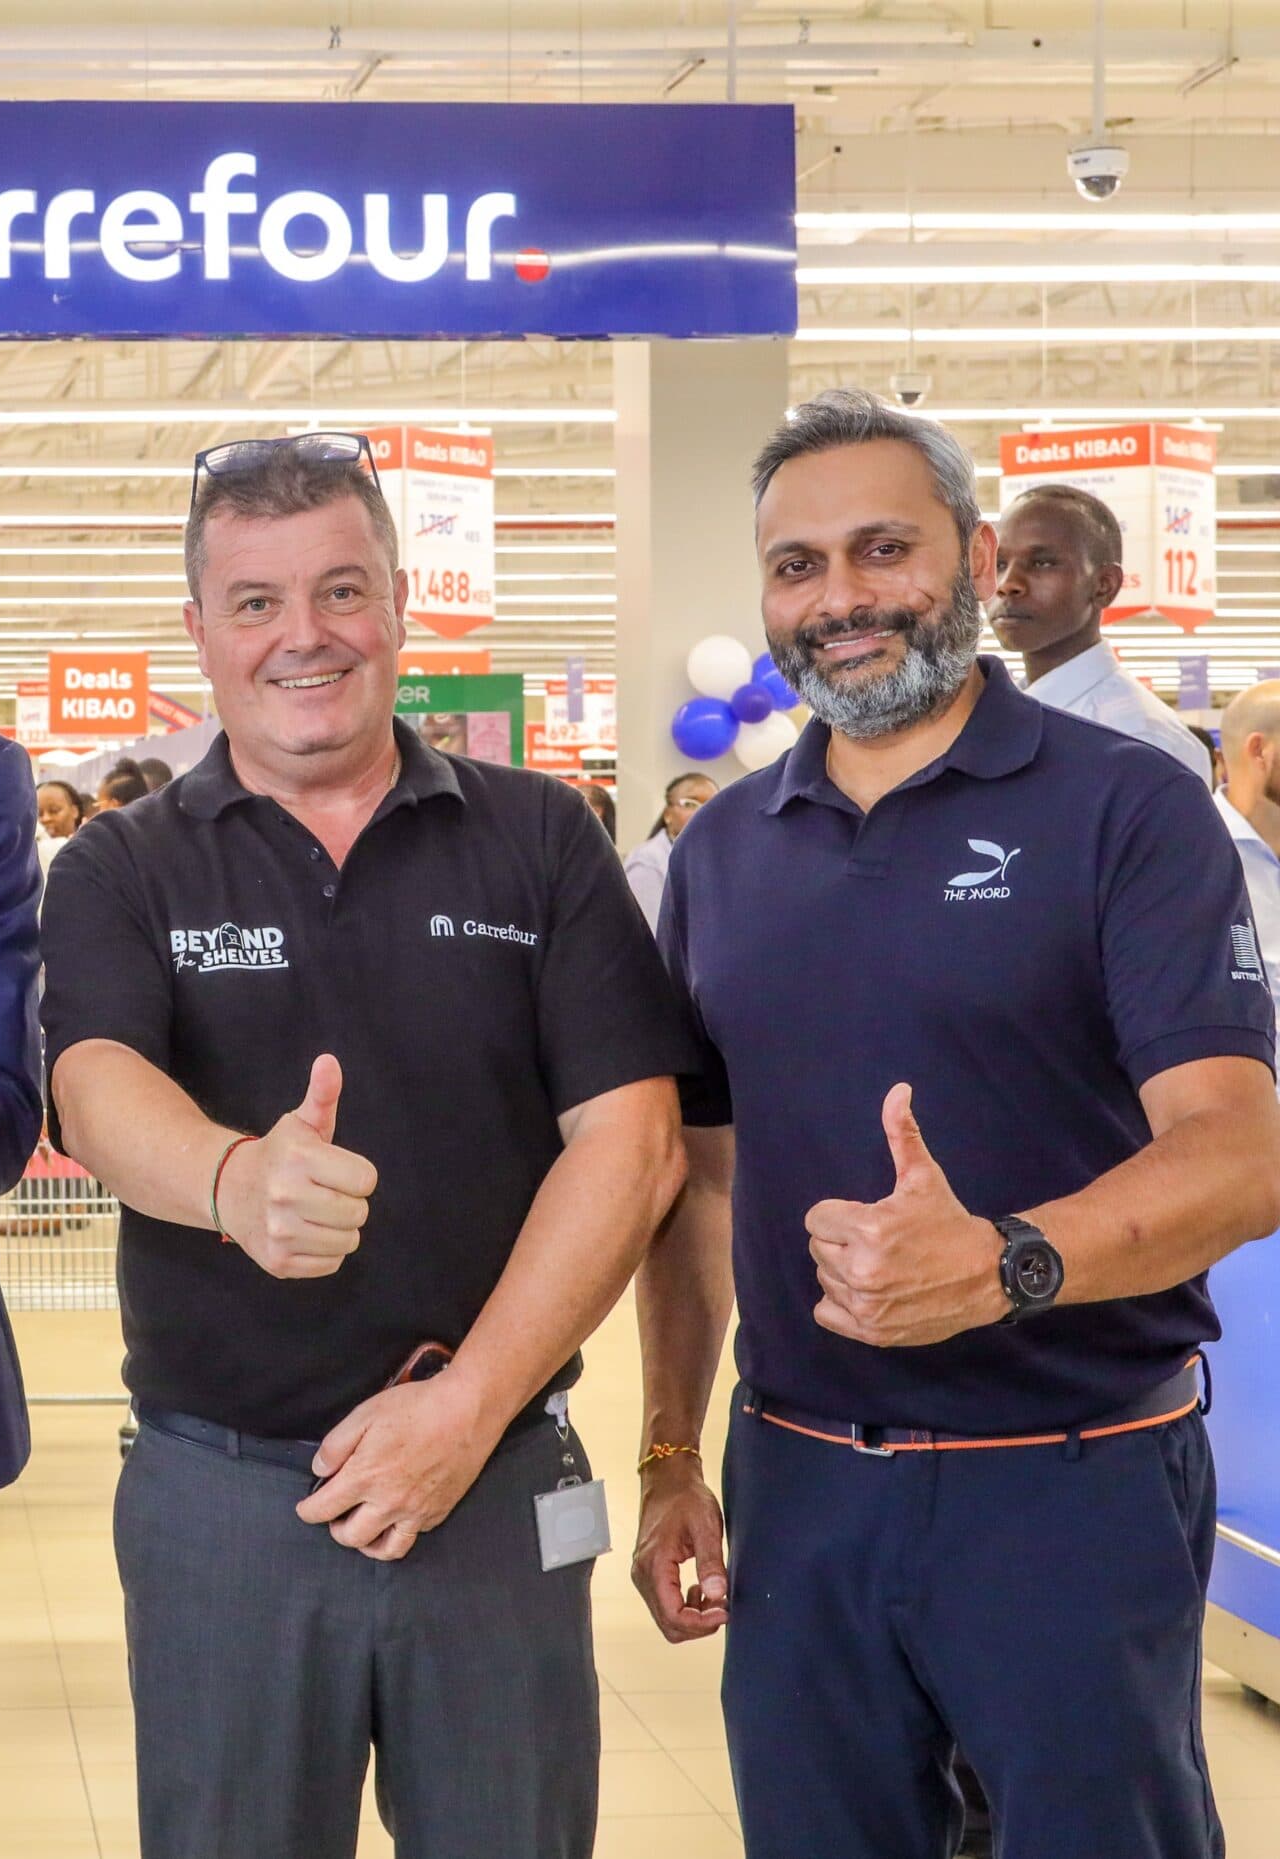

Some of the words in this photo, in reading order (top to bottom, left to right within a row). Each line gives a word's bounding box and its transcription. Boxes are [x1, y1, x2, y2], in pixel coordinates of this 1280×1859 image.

[414, 441, 449, 462] Deals
[449, 445, 487, 467] KIBAO
[1016, 443, 1070, 464] Deals
[1074, 437, 1137, 459] KIBAO
[1164, 549, 1197, 596] 112
[412, 567, 471, 606] 1,488
[65, 667, 133, 690] Deals
[61, 698, 137, 720] KIBAO
[944, 889, 967, 901] THE
[463, 920, 538, 946] Carrefour
[202, 948, 283, 967] SHELVES
